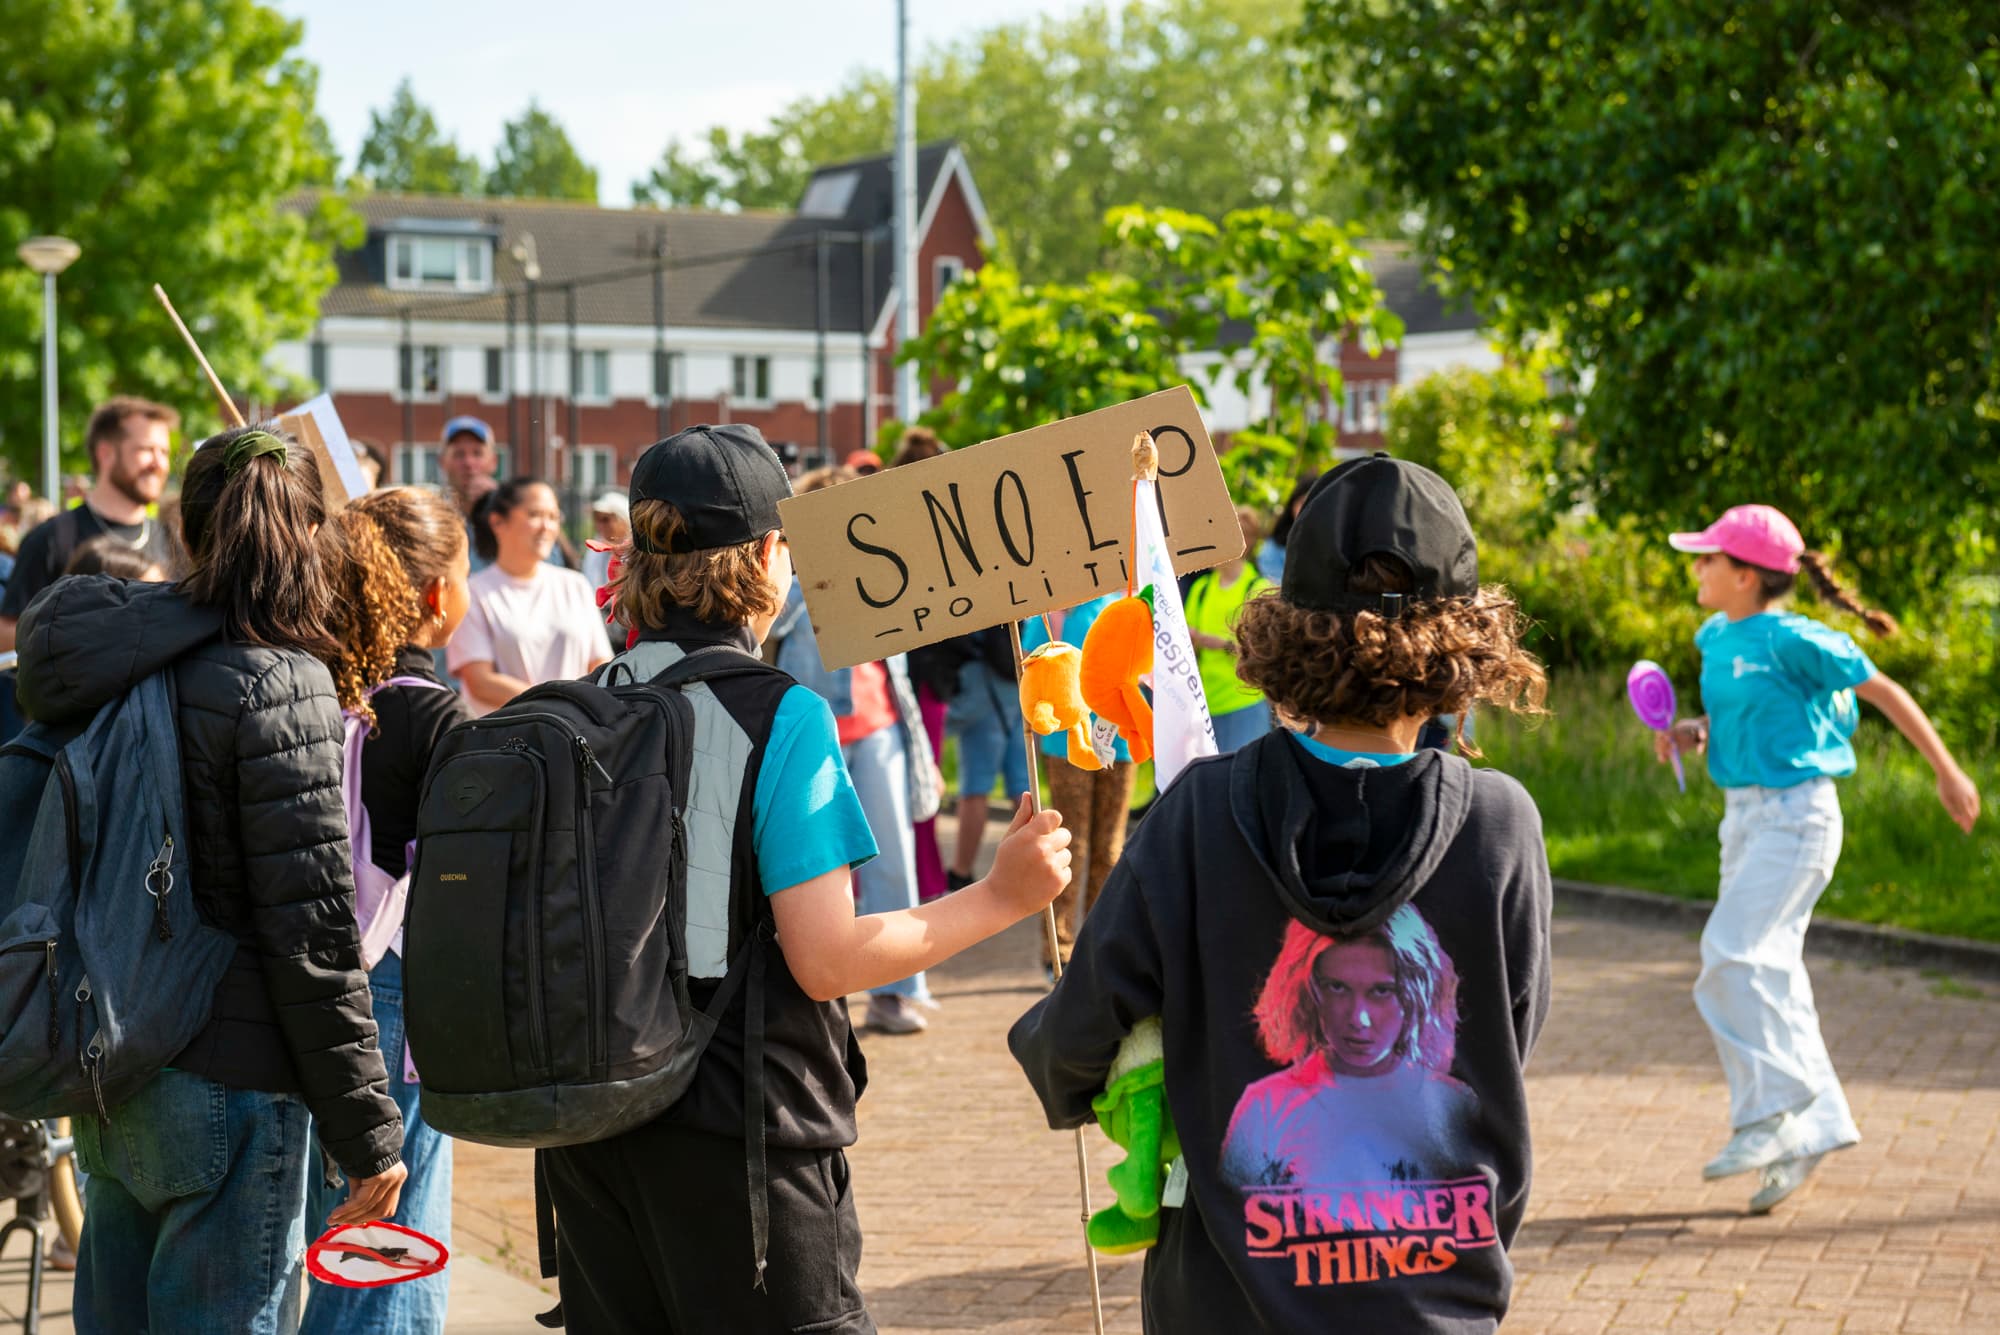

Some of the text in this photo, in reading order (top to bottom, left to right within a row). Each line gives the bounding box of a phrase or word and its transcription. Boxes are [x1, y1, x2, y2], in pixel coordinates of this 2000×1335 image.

[440, 873, 468, 881] QUECHUA
[1244, 1185, 1495, 1249] STRANGER
[1287, 1235, 1457, 1287] THINGS
